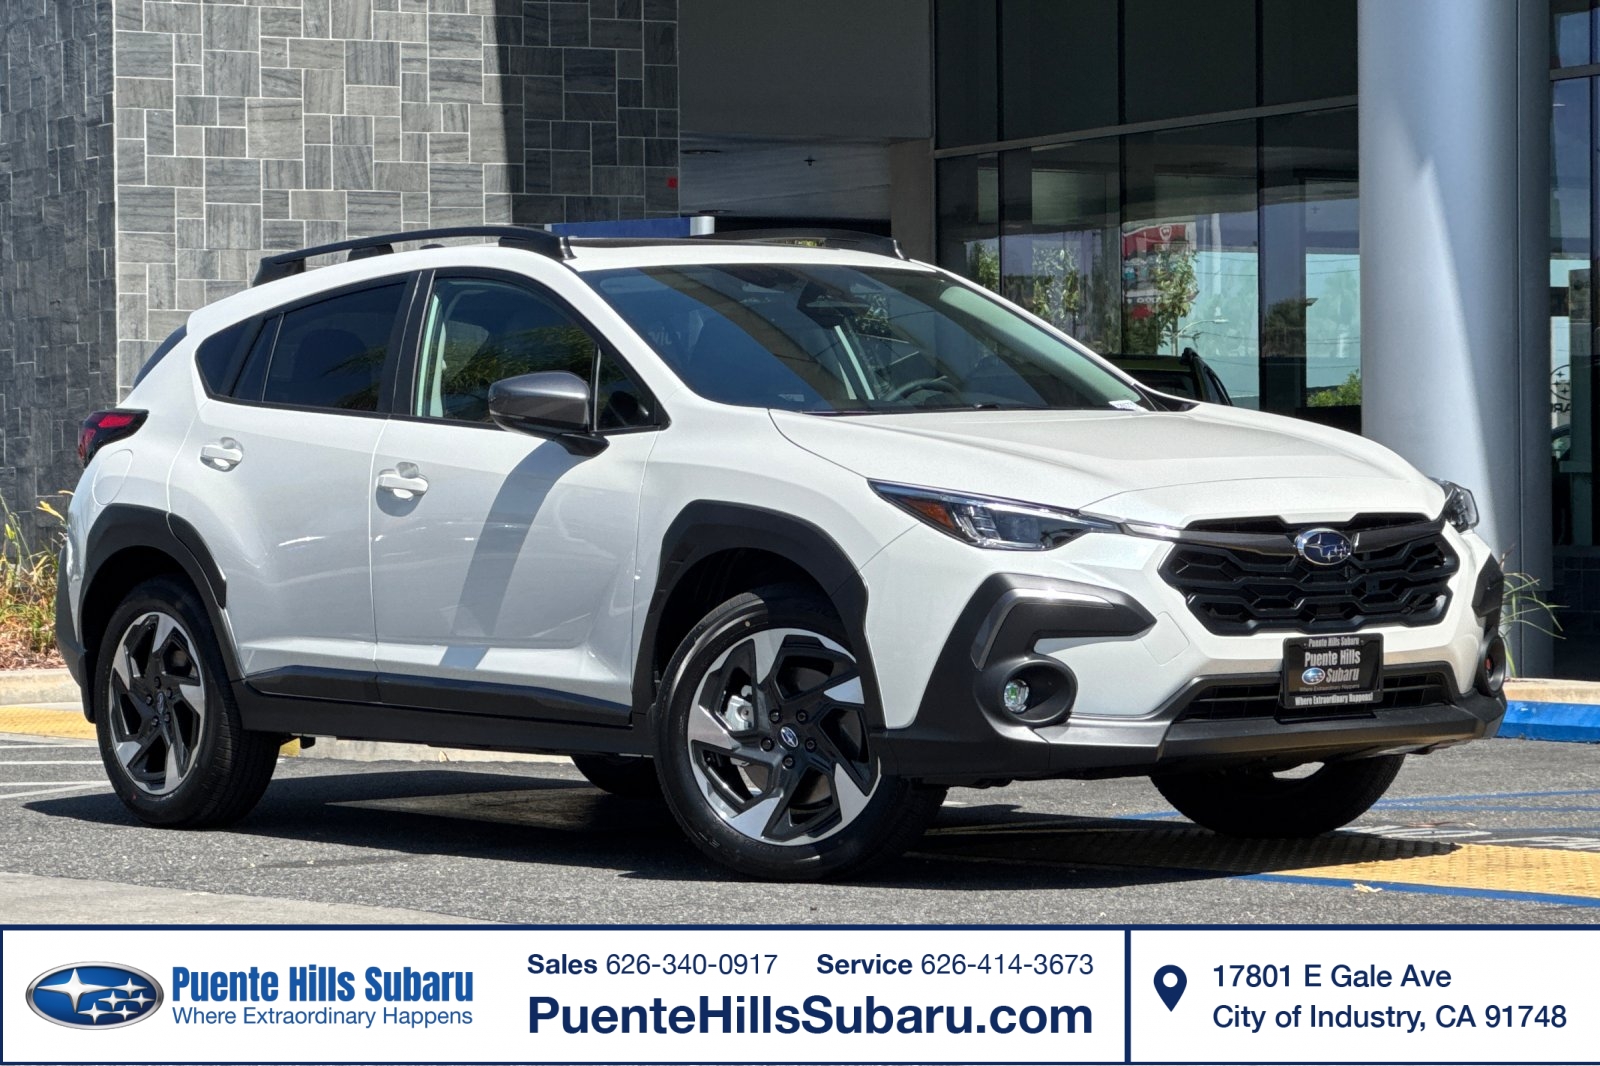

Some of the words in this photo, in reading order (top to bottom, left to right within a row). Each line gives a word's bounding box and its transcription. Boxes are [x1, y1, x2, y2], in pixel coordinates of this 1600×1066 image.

[1327, 637, 1340, 647] Hills
[1304, 650, 1338, 667] Puente
[1339, 648, 1361, 665] Hills
[1326, 667, 1360, 683] Subaru
